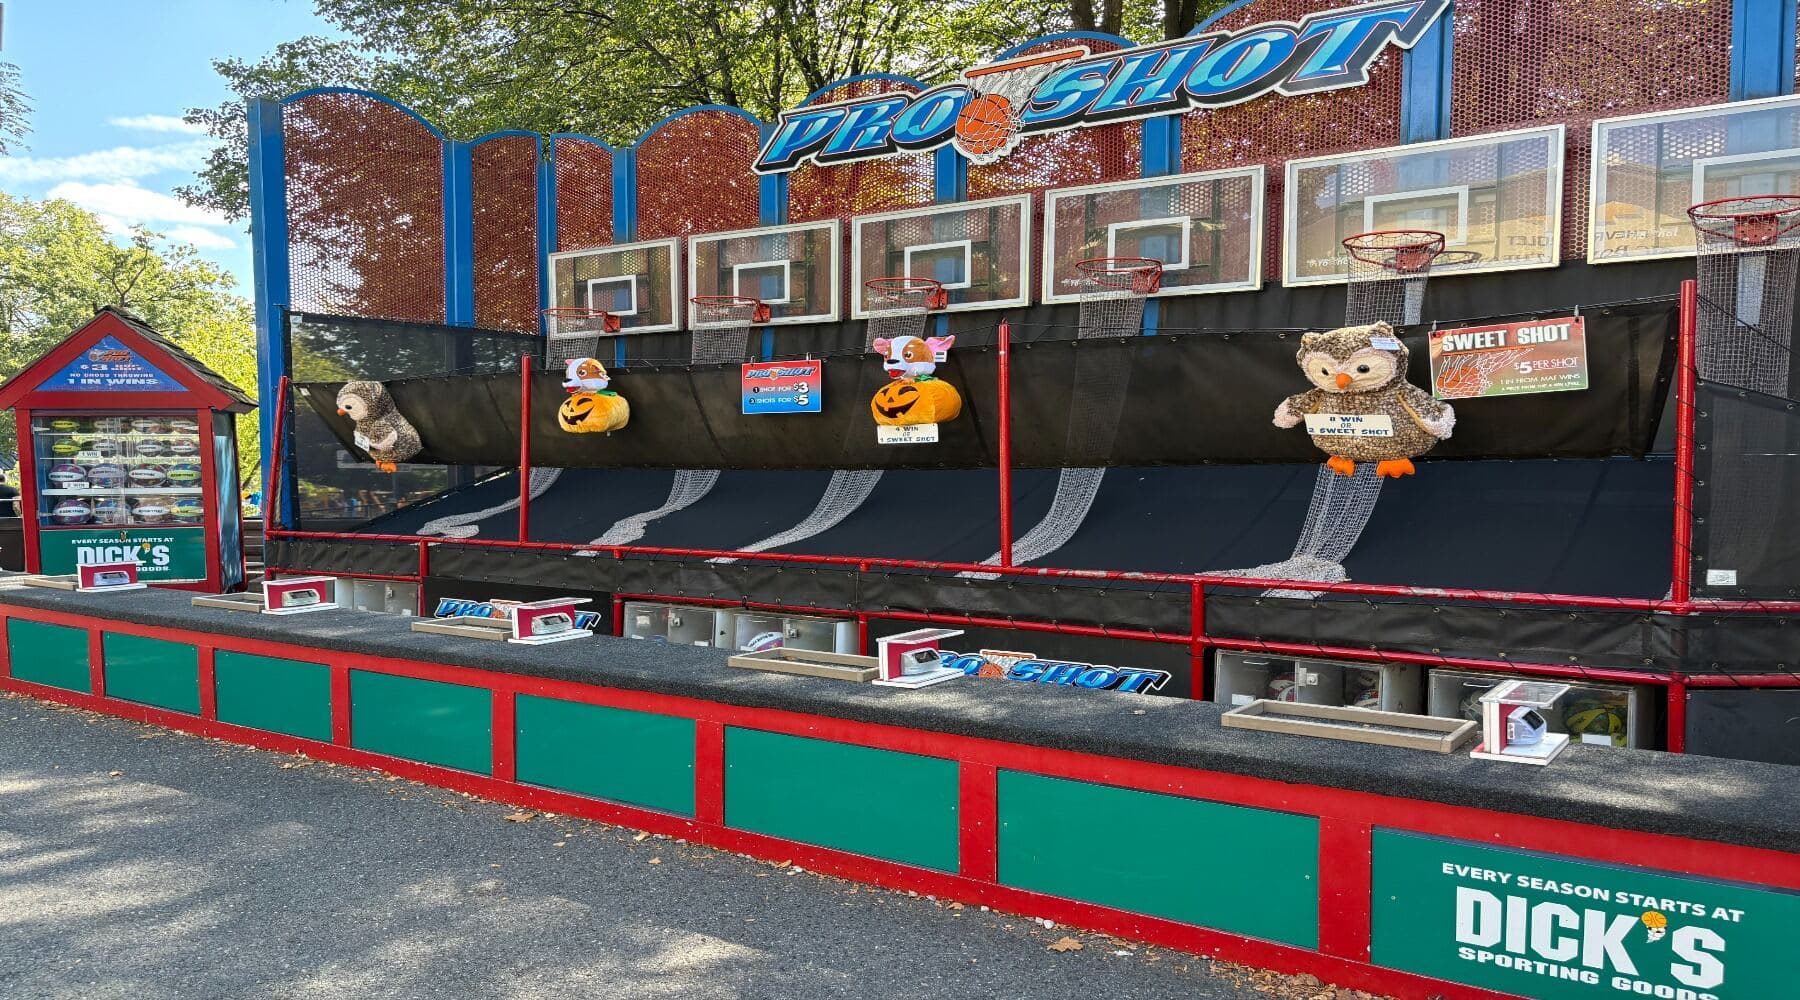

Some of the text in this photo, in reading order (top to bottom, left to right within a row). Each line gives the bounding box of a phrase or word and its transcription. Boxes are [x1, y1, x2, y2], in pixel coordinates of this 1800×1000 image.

[756, 1, 1426, 168] PRO SHOT
[1442, 323, 1570, 352] SWEET SHOT
[1514, 356, 1578, 374] $5 PER SHOT
[793, 381, 810, 394] $3
[793, 394, 810, 406] $5
[77, 544, 170, 566] DICK'S
[1006, 660, 1161, 693] SHOT
[1442, 862, 1745, 923] EVERY SEASON STARTS AT
[1455, 885, 1726, 990] DICK'S
[1458, 945, 1600, 985] SPORTING
